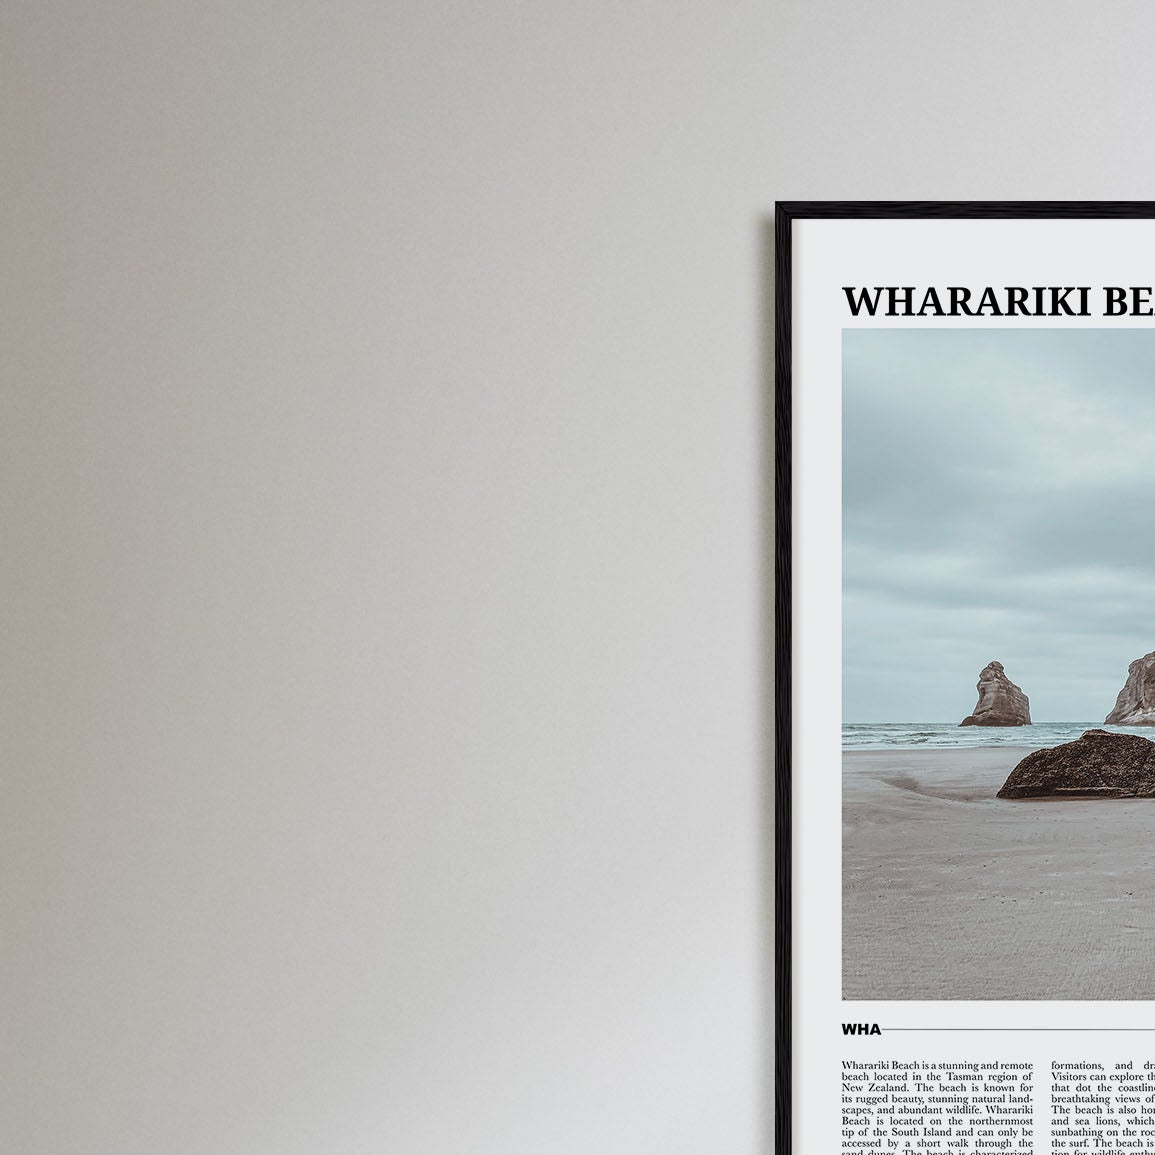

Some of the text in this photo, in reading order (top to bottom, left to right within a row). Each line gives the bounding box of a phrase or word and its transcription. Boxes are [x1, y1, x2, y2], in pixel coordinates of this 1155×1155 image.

[842, 287, 1091, 316] WHARARIKI
[841, 1023, 882, 1036] WHA
[842, 1061, 890, 1070] Wharariki
[891, 1061, 920, 1070] Beach
[922, 1061, 930, 1070] is
[938, 1061, 979, 1072] stunning
[981, 1061, 999, 1070] and
[1000, 1062, 1034, 1070] remote
[1051, 1061, 1105, 1071] formations,
[1114, 1061, 1134, 1070] and
[841, 1072, 1033, 1083] beach located in the Tasman region of
[1051, 1072, 1088, 1081] Visitors
[1108, 1072, 1145, 1083] explore
[1050, 1083, 1071, 1092] that
[1075, 1083, 1092, 1092] dot
[1097, 1083, 1113, 1092] the
[841, 1094, 1034, 1105] its rugged beauty, stunning natural land-
[1051, 1094, 1111, 1105] breathtaking
[1114, 1094, 1141, 1103] views
[1144, 1094, 1155, 1103] of
[841, 1105, 1034, 1116] scapes, and abundant wildlife. Wharariki
[841, 1116, 871, 1125] Beach
[876, 1116, 885, 1125] is
[889, 1116, 924, 1125] located
[948, 1116, 964, 1125] the
[969, 1116, 1034, 1125] northernmost
[1050, 1116, 1070, 1125] and
[1095, 1116, 1121, 1126] lions,
[1126, 1116, 1155, 1125] which
[1050, 1127, 1104, 1138] sunbathing
[1121, 1127, 1138, 1136] the
[841, 1138, 882, 1147] accessed
[887, 1138, 900, 1149] by
[916, 1138, 942, 1147] short
[946, 1138, 969, 1147] walk
[974, 1138, 1013, 1149] through
[1018, 1138, 1034, 1147] the
